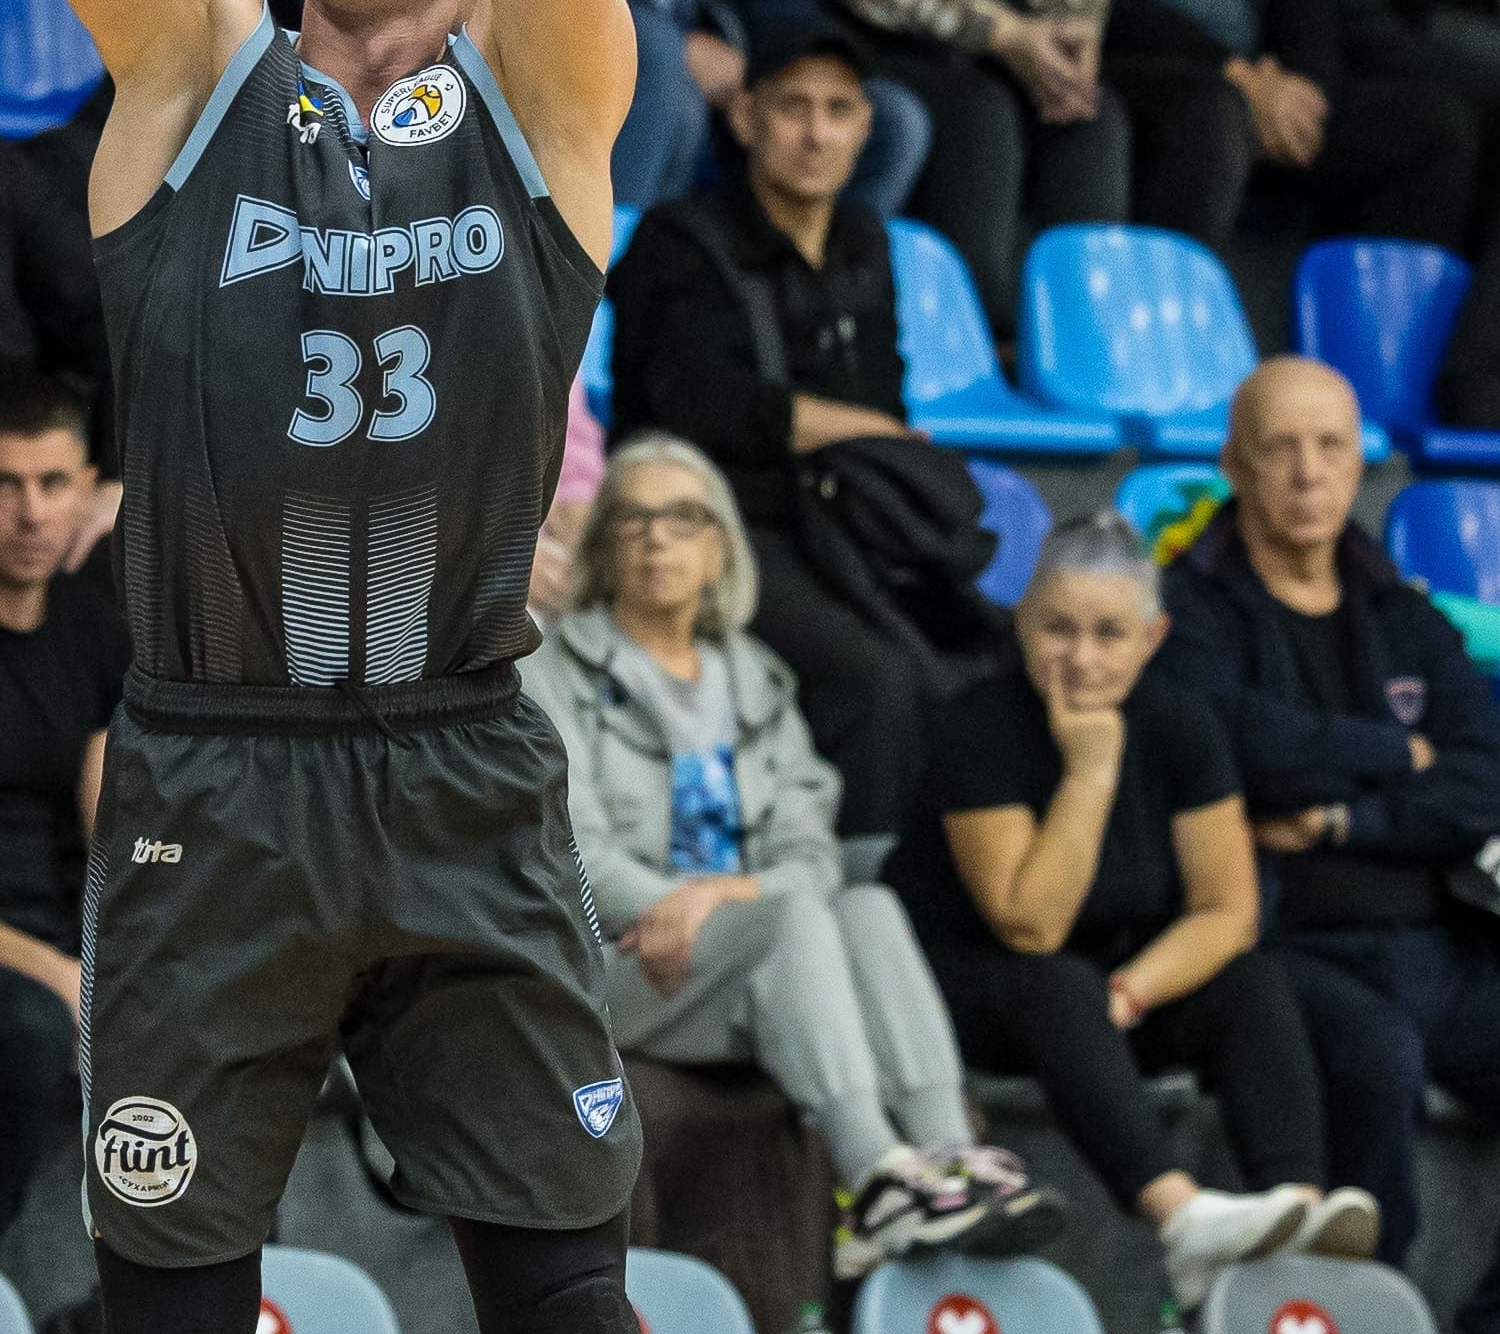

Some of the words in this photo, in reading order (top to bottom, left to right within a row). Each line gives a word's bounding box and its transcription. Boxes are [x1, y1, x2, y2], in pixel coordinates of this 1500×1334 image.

[409, 111, 453, 138] FAVBET
[219, 193, 505, 297] DNIPRO
[287, 325, 438, 449] 33
[132, 1114, 154, 1123] 2002
[103, 1129, 192, 1174] flint
